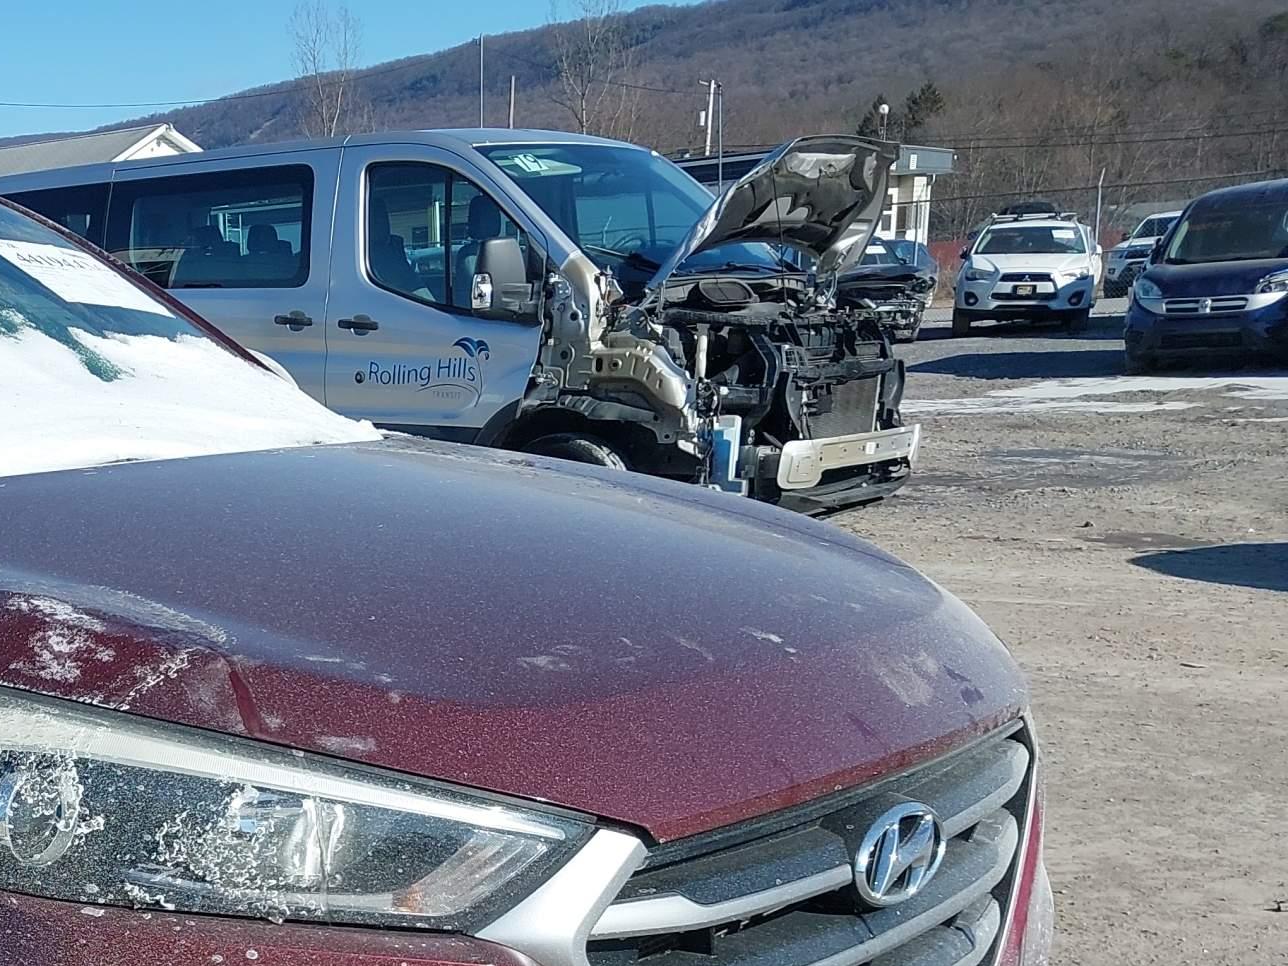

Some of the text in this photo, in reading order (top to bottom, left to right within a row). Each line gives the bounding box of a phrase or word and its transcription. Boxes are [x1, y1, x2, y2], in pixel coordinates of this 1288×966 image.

[368, 357, 476, 387] Rolling Hills
[432, 390, 461, 400] TRANSIT
